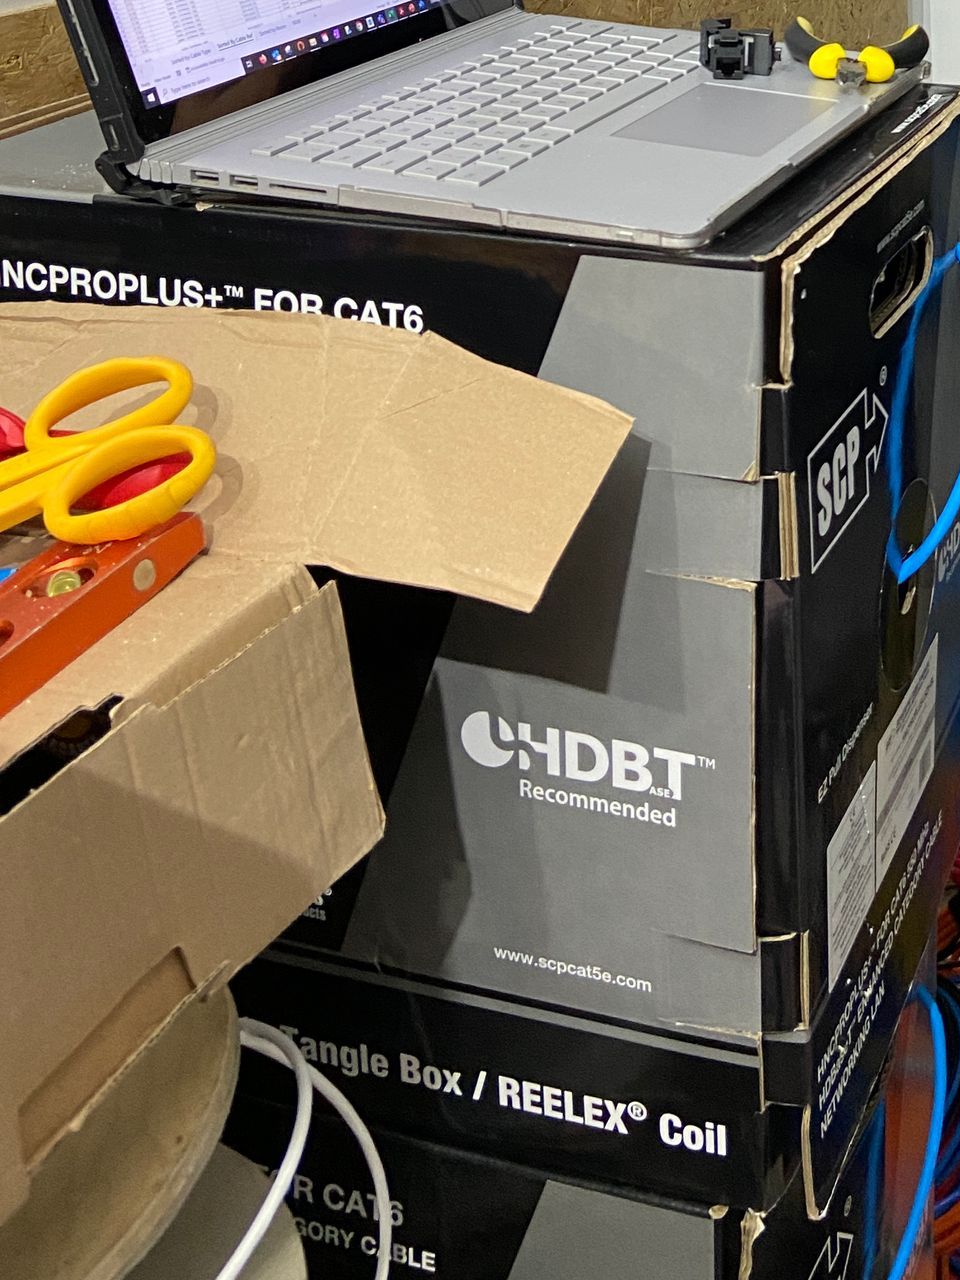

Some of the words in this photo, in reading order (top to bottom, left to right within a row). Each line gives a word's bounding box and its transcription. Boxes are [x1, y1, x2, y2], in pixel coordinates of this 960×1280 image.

[254, 287, 323, 315] FOR
[333, 296, 424, 334] CAT6
[816, 425, 860, 537] SCP
[519, 778, 677, 828] Recommended
[876, 908, 891, 950] FOR
[891, 871, 907, 914] CAT6
[894, 851, 925, 935] CATEGORY
[925, 808, 943, 859] CABLE
[493, 946, 653, 993] www.scpcat5e.com
[820, 1015, 871, 1139] NETWORKING
[871, 979, 886, 1019] LAN
[399, 1052, 463, 1097] Box
[472, 1070, 488, 1102] /
[658, 1112, 728, 1157] Coil
[361, 1235, 436, 1273] CBLE
